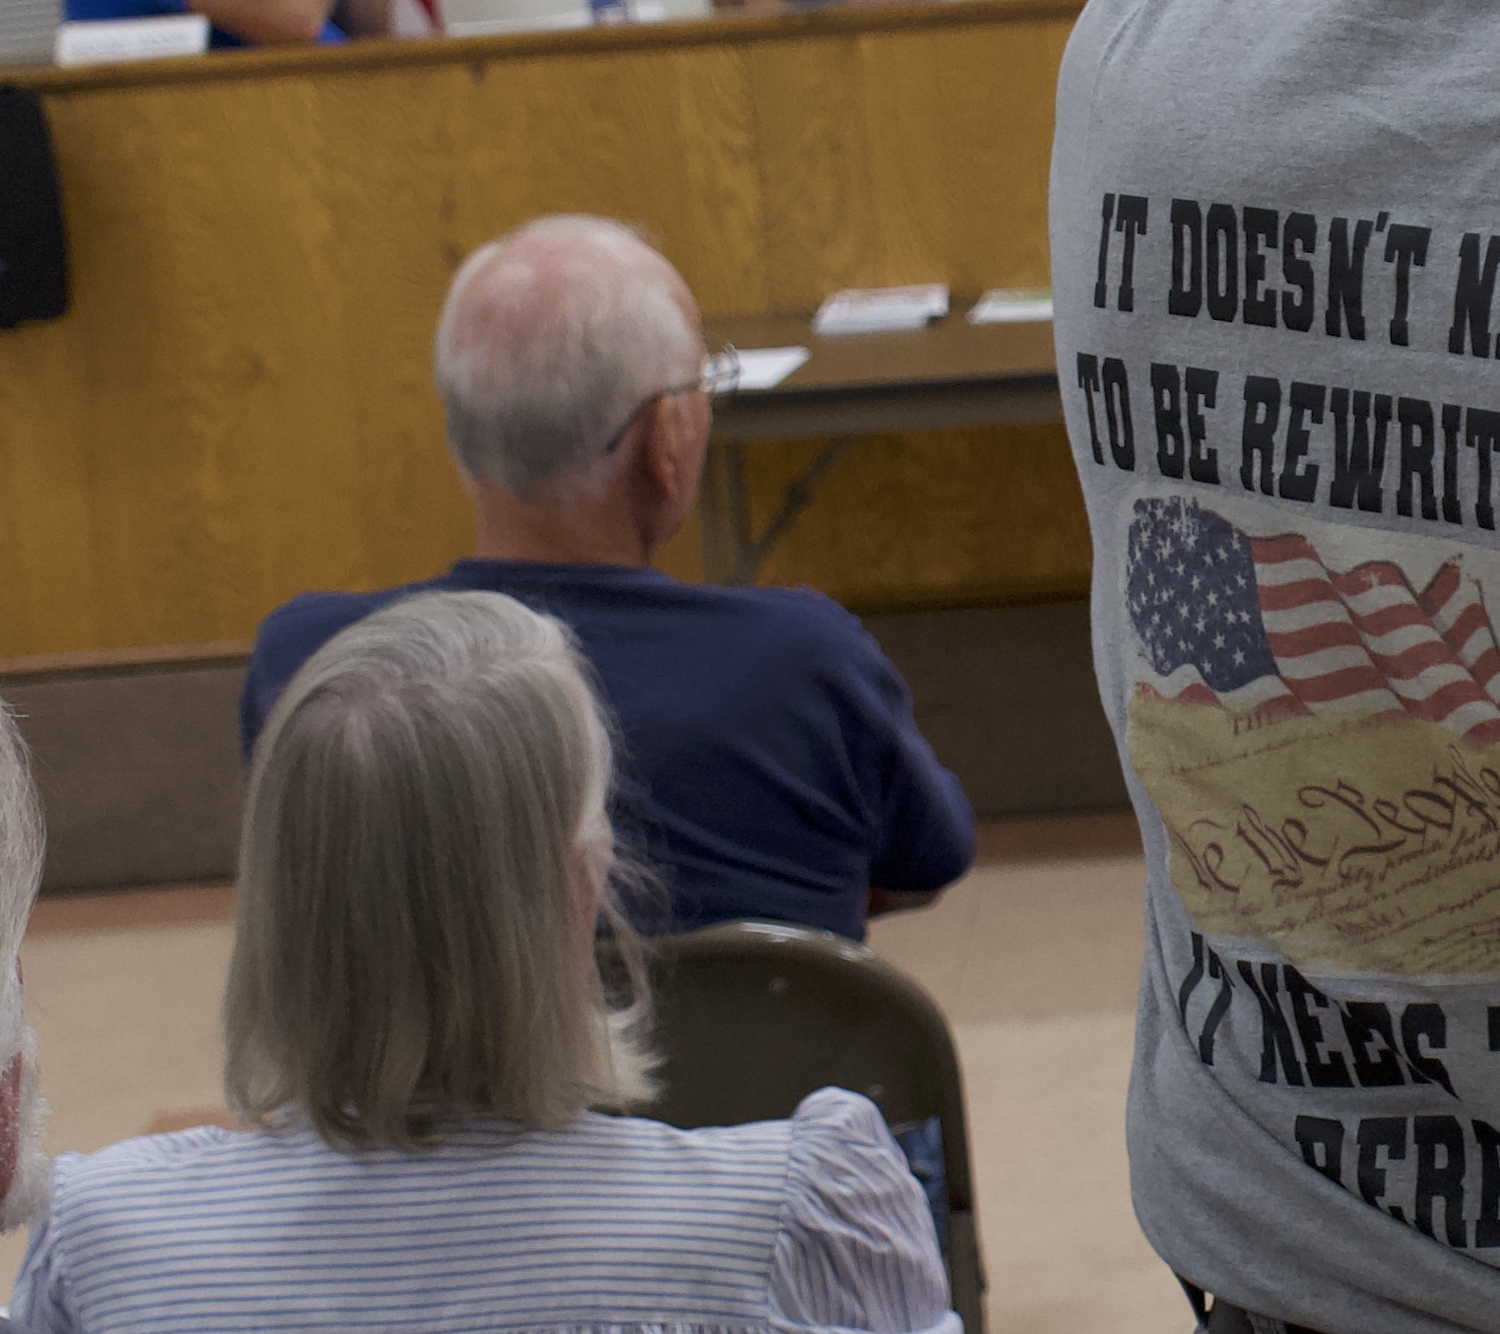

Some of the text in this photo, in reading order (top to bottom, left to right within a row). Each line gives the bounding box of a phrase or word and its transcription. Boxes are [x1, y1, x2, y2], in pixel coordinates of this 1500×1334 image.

[1094, 193, 1148, 312] IT
[1169, 198, 1431, 346] DOESN'T
[1077, 352, 1135, 471] TO
[1151, 362, 1220, 485] BE
